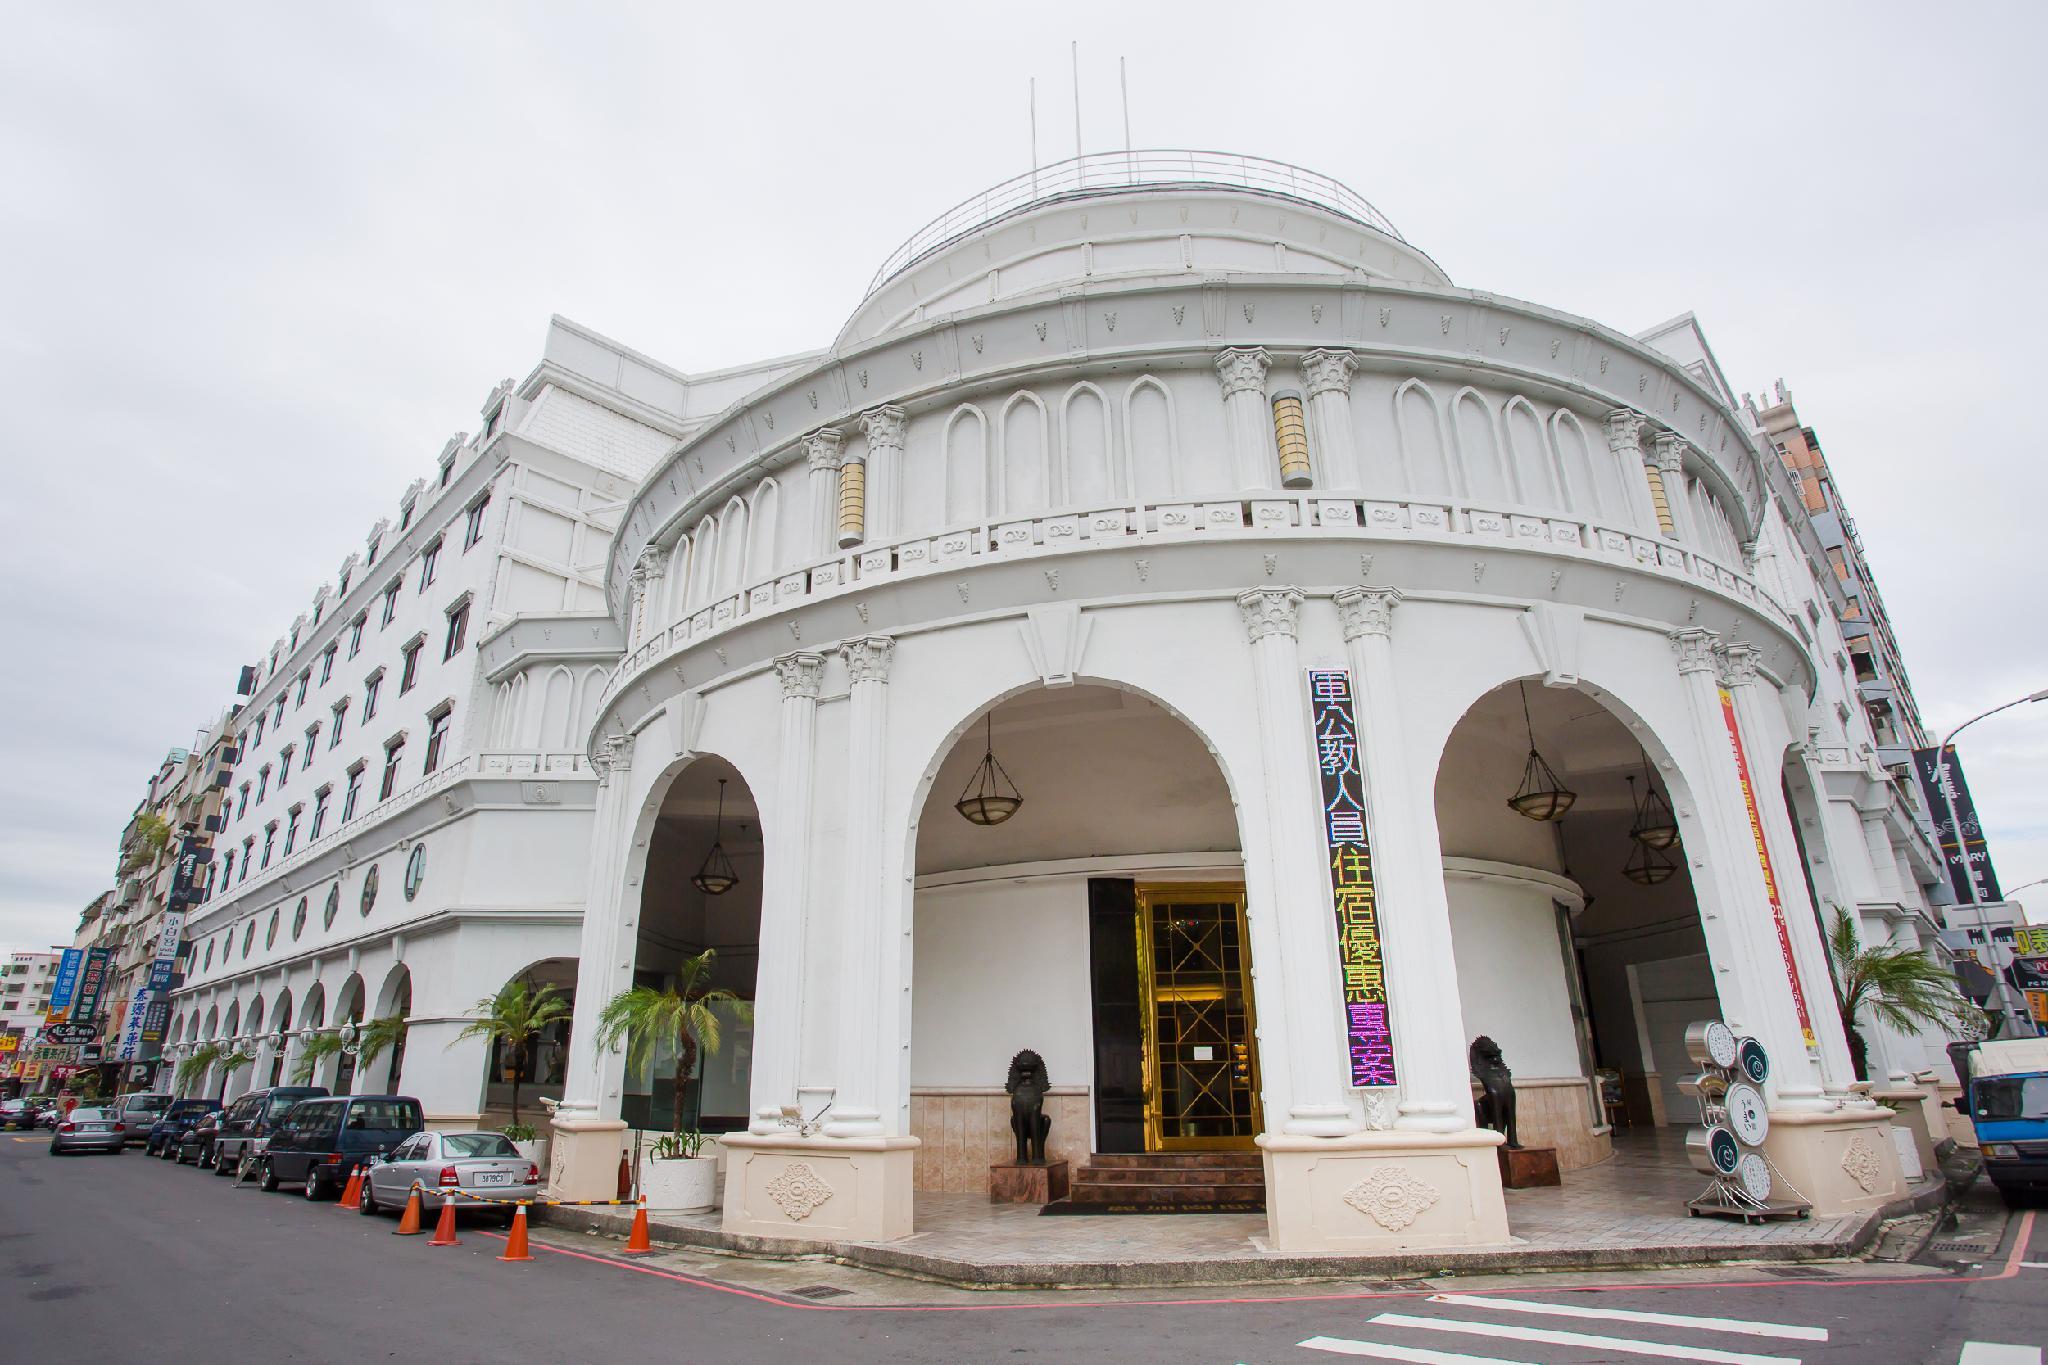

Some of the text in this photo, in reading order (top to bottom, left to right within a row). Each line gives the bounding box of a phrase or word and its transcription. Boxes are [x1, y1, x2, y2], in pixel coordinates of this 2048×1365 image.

[1312, 672, 1397, 1086] 軍公教人員住宿優惠專案
